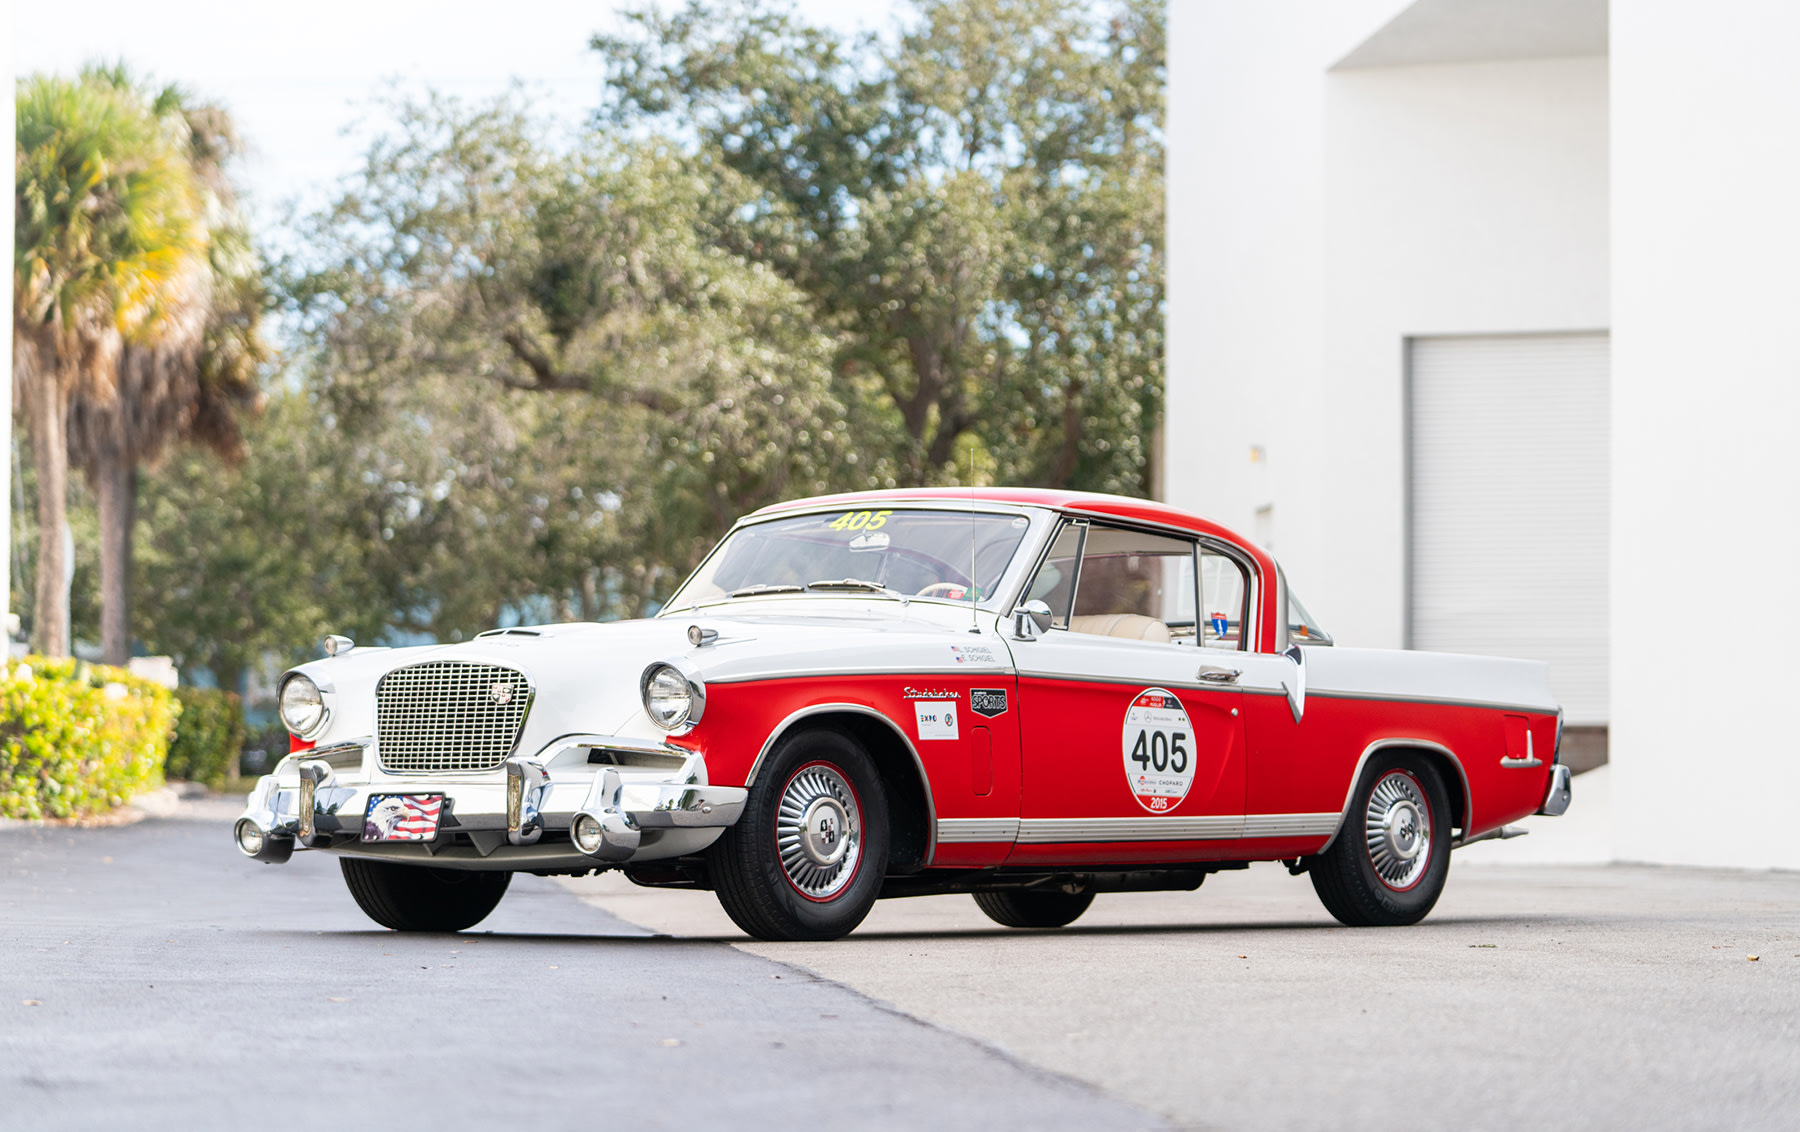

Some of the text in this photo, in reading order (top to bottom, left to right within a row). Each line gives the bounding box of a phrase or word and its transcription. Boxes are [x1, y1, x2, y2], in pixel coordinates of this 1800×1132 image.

[829, 510, 893, 531] 405
[903, 686, 961, 699] Studebaker
[972, 694, 1006, 710] SPORTS
[1131, 729, 1188, 774] 405
[1150, 797, 1168, 809] 2015
